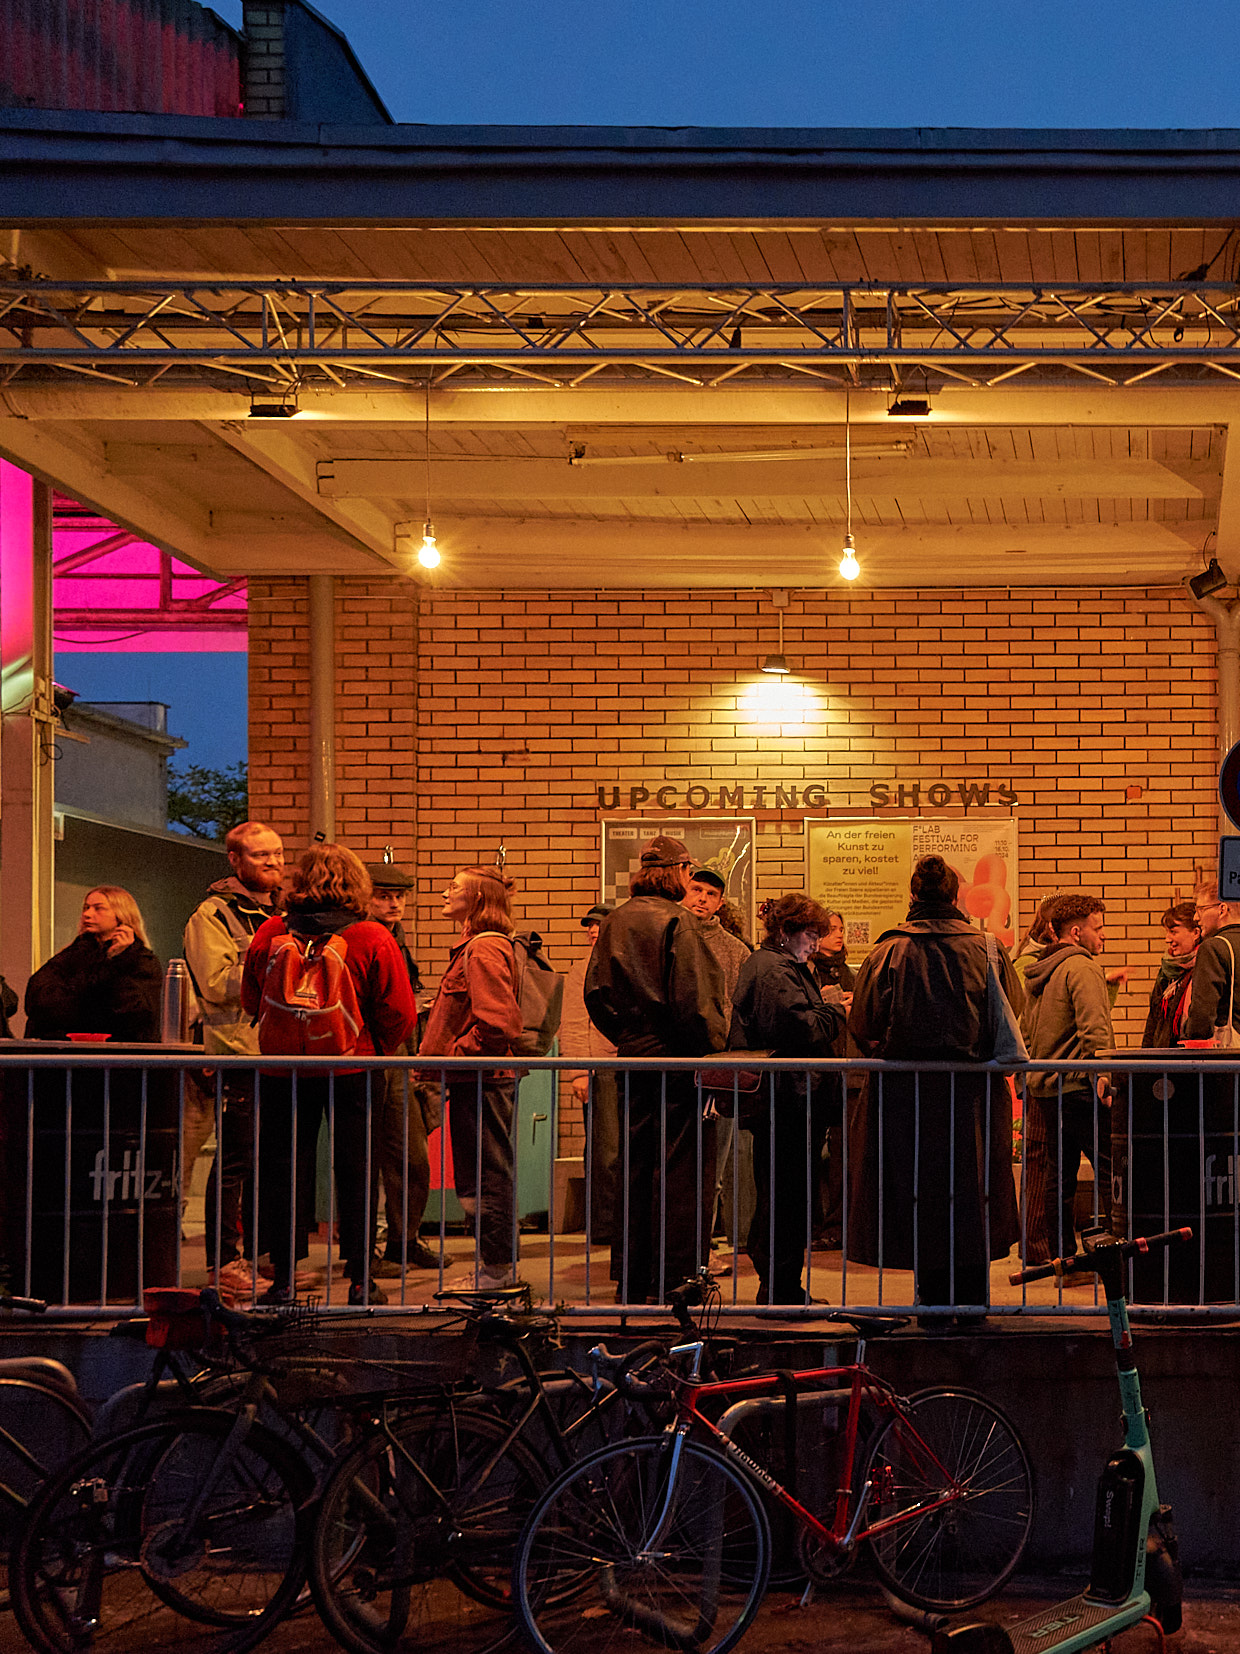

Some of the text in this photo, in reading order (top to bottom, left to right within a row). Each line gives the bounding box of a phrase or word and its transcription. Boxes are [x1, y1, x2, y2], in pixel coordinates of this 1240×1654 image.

[598, 783, 1018, 810] UPCOMING SHOWS
[826, 831, 895, 839] An der freien
[913, 834, 979, 843] FESTIVAL FOR
[837, 843, 869, 851] Kunst
[913, 844, 977, 853] PERFORMING
[823, 855, 899, 865] sparen, kostet
[858, 867, 879, 875] viel!
[1026, 1615, 1080, 1638] TIER
